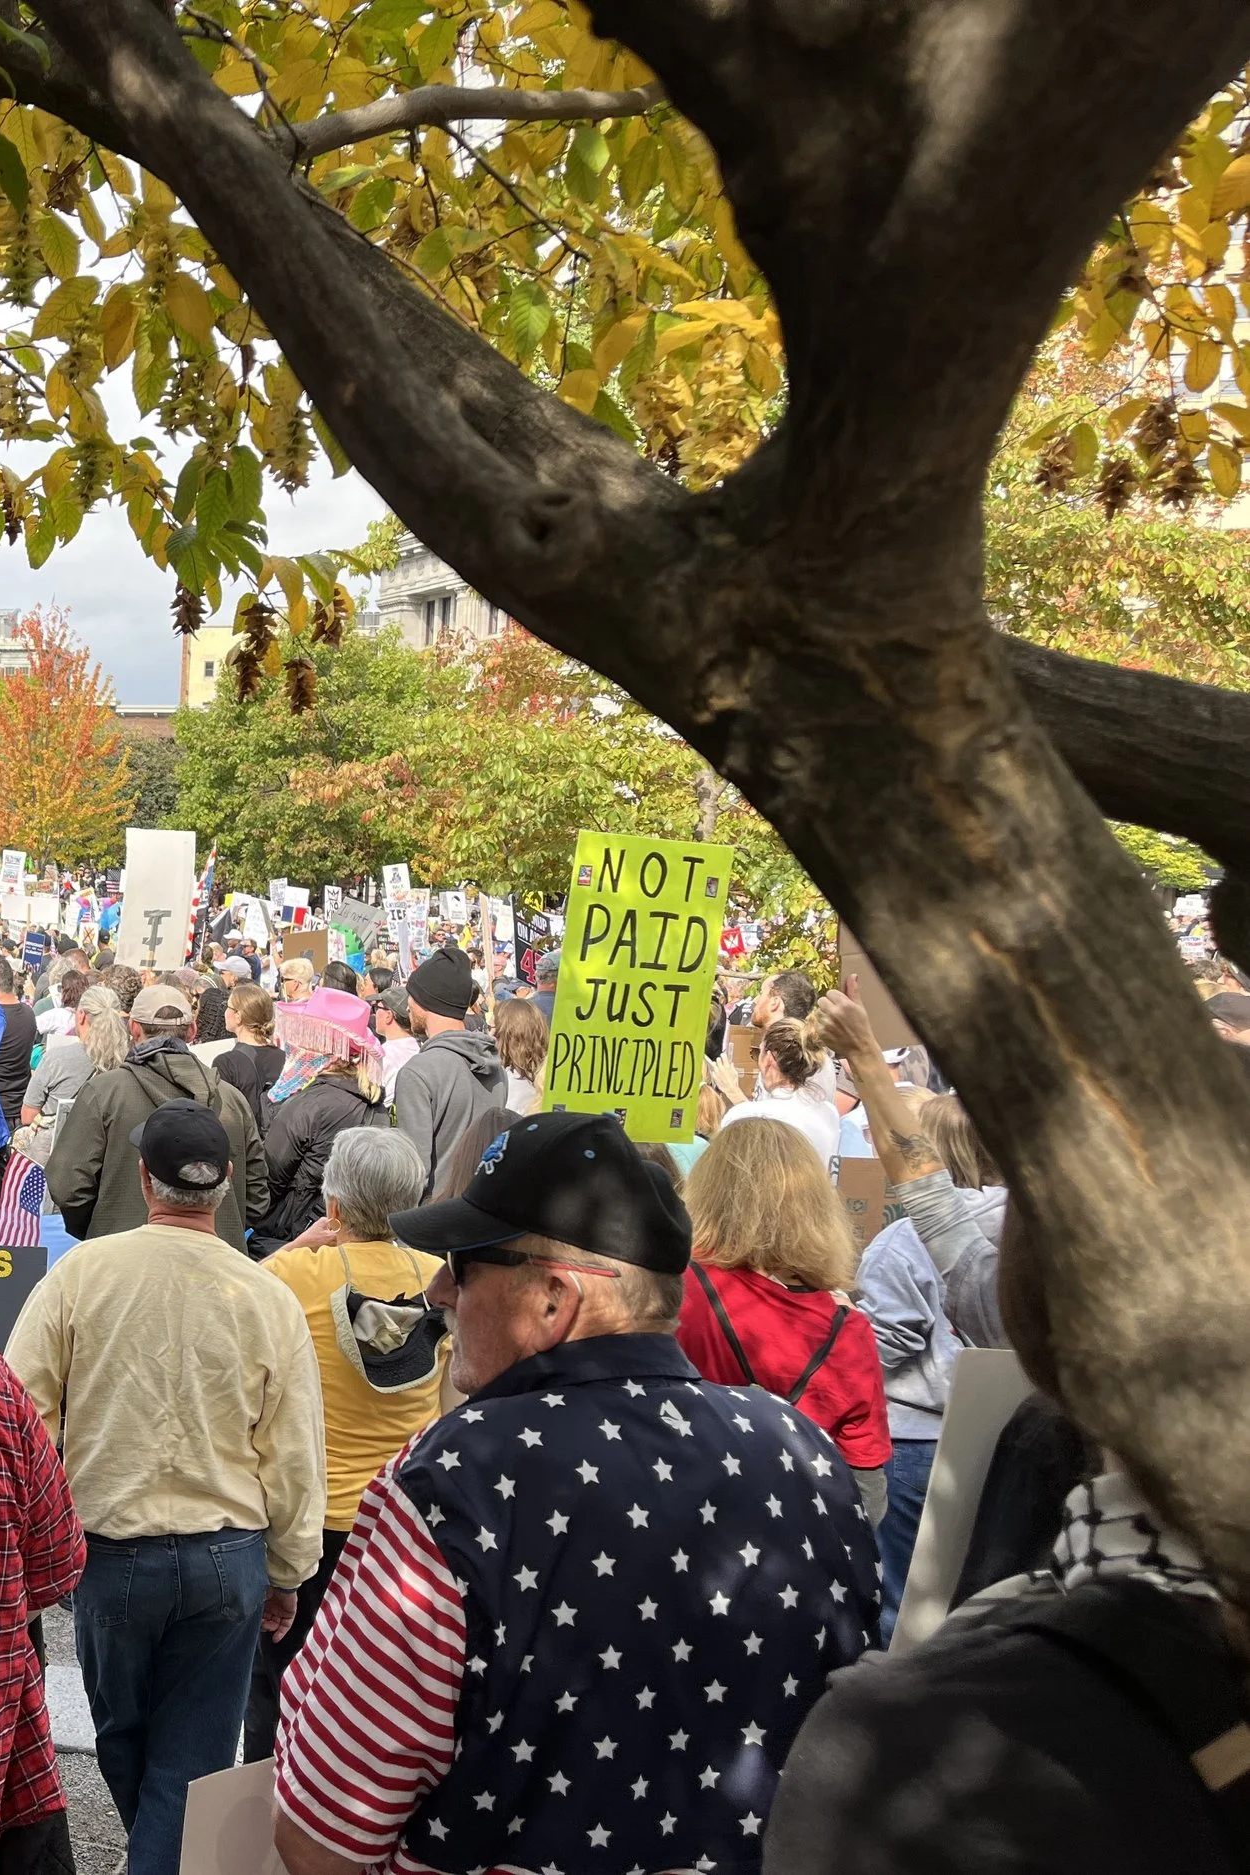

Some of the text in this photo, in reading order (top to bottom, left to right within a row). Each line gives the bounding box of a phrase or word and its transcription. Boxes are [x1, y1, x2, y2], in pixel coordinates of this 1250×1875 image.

[597, 848, 705, 902] NOT
[579, 903, 707, 974] PAID.
[575, 978, 690, 1028] JUST
[550, 1033, 694, 1100] PRINCIPLED.
